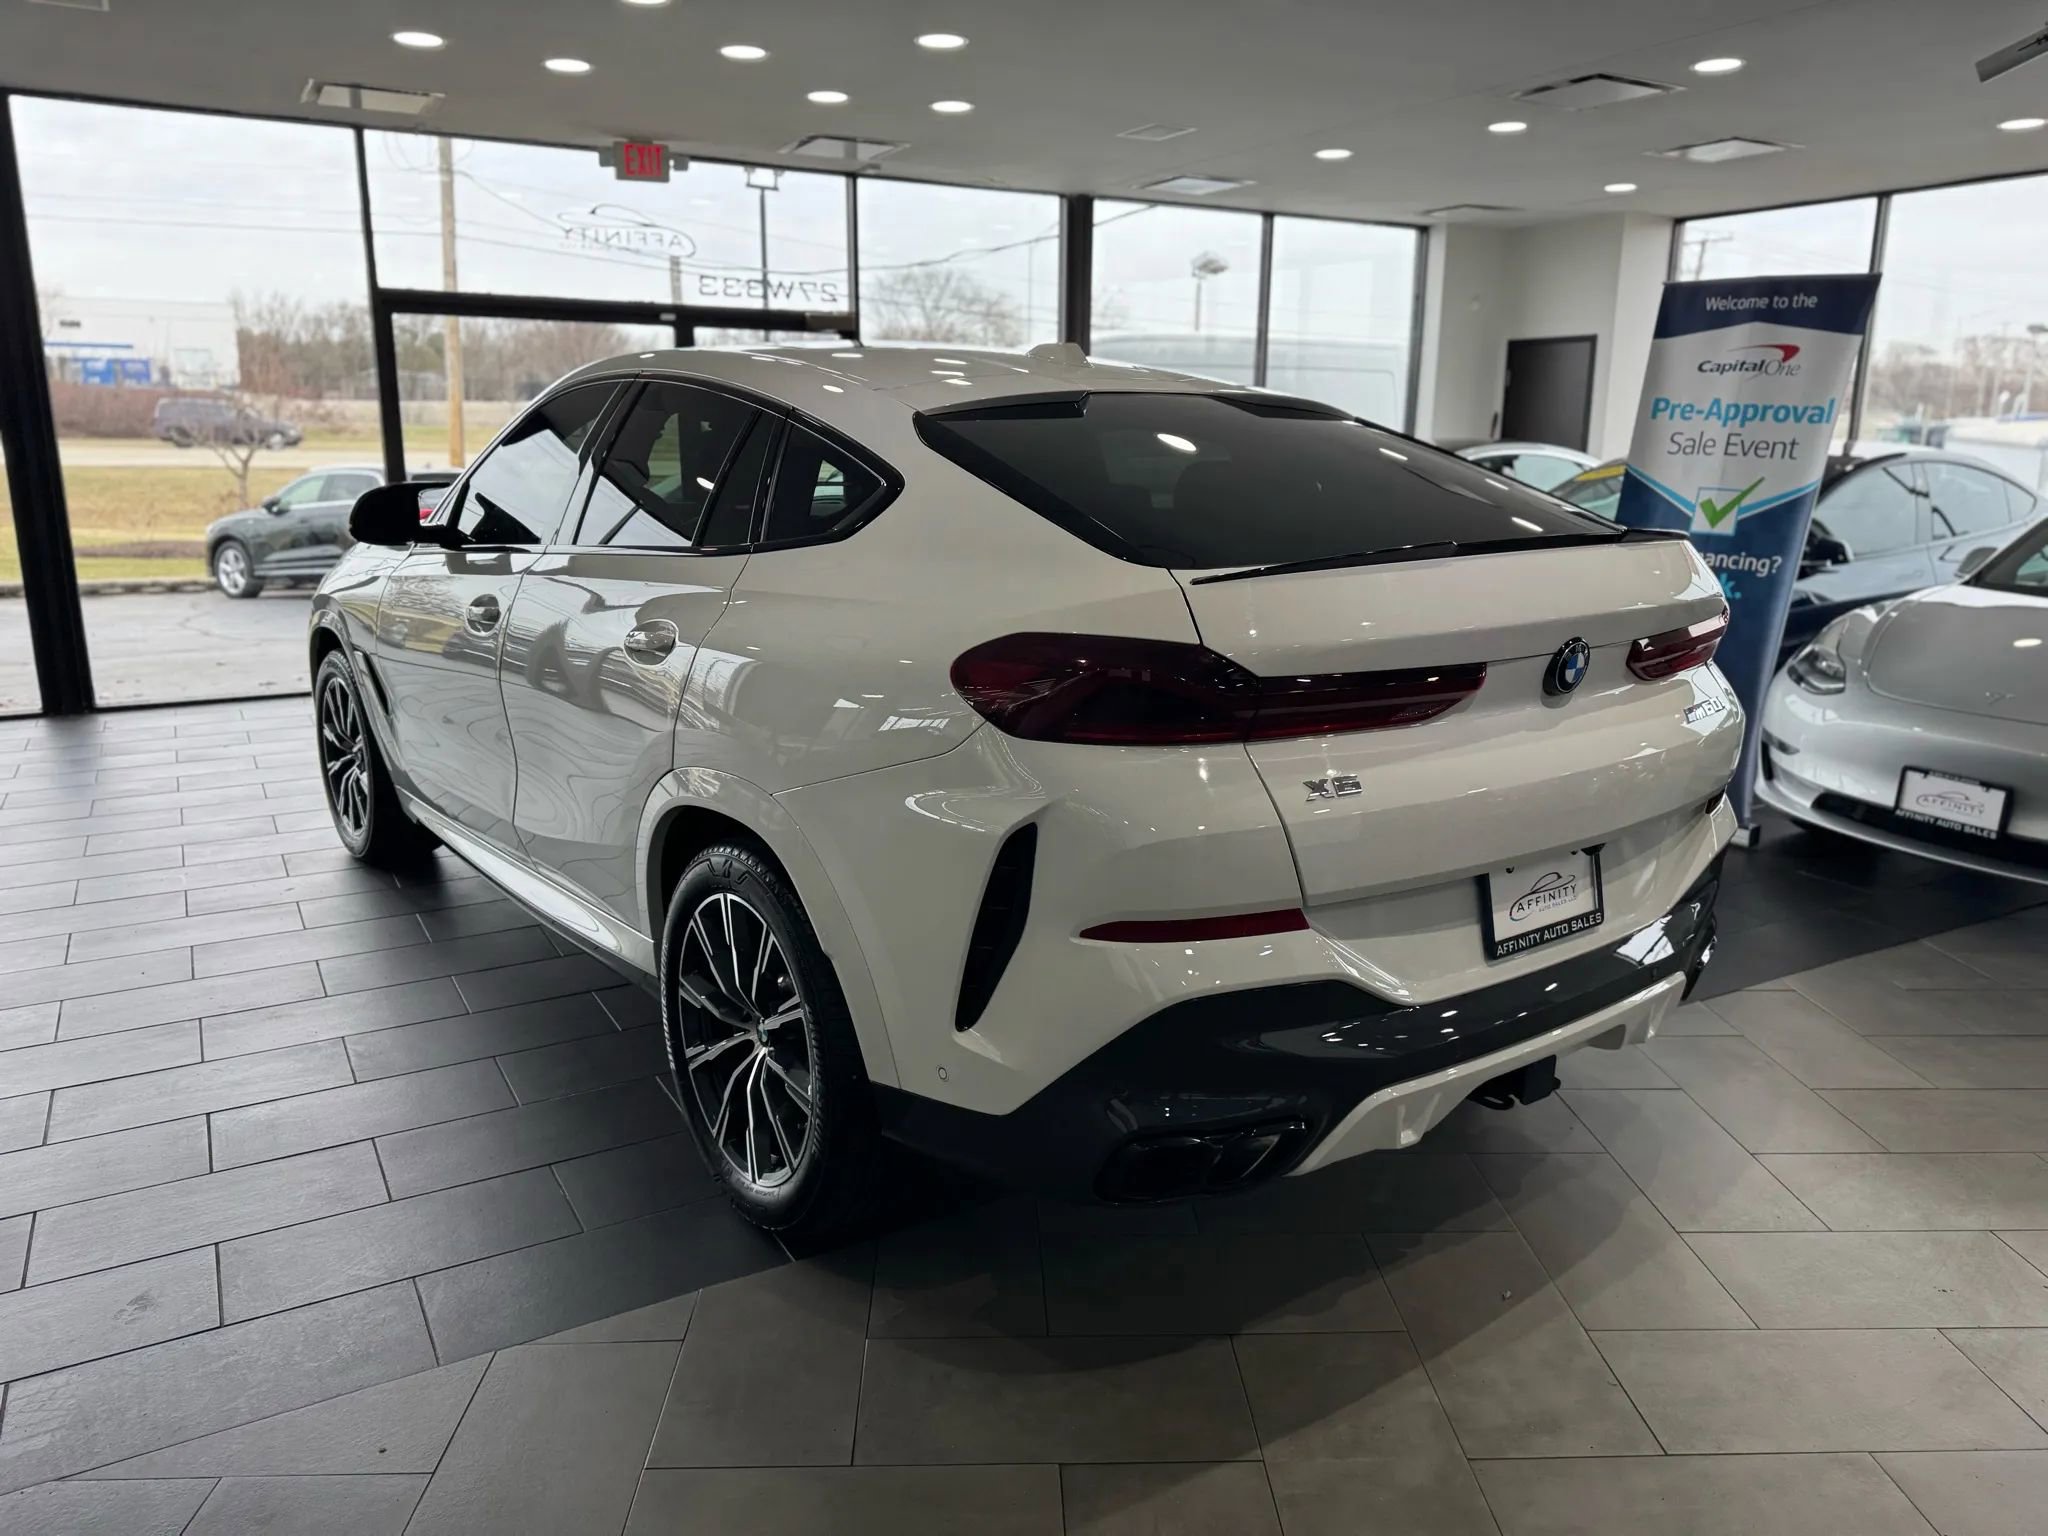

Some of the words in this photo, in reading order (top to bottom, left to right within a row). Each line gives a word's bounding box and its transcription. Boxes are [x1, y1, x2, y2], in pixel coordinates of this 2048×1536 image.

[623, 143, 663, 177] EXIT
[1705, 294, 1769, 312] Welcome
[1772, 295, 1788, 309] to
[1793, 293, 1818, 309] the
[1650, 397, 1836, 428] Pre-Approval
[1667, 431, 1716, 456] Sale
[1723, 434, 1800, 461] Event
[1700, 551, 1782, 577] ancing?
[1302, 774, 1363, 802] X6
[1894, 808, 1935, 825] AFFINITY
[1936, 817, 1962, 831] AUTO
[1963, 825, 1997, 840] SALES
[1516, 883, 1577, 913] AFFINITY
[1496, 931, 1541, 957] AFFINITY
[1543, 923, 1569, 941] AUTO
[1571, 912, 1602, 931] SALES
